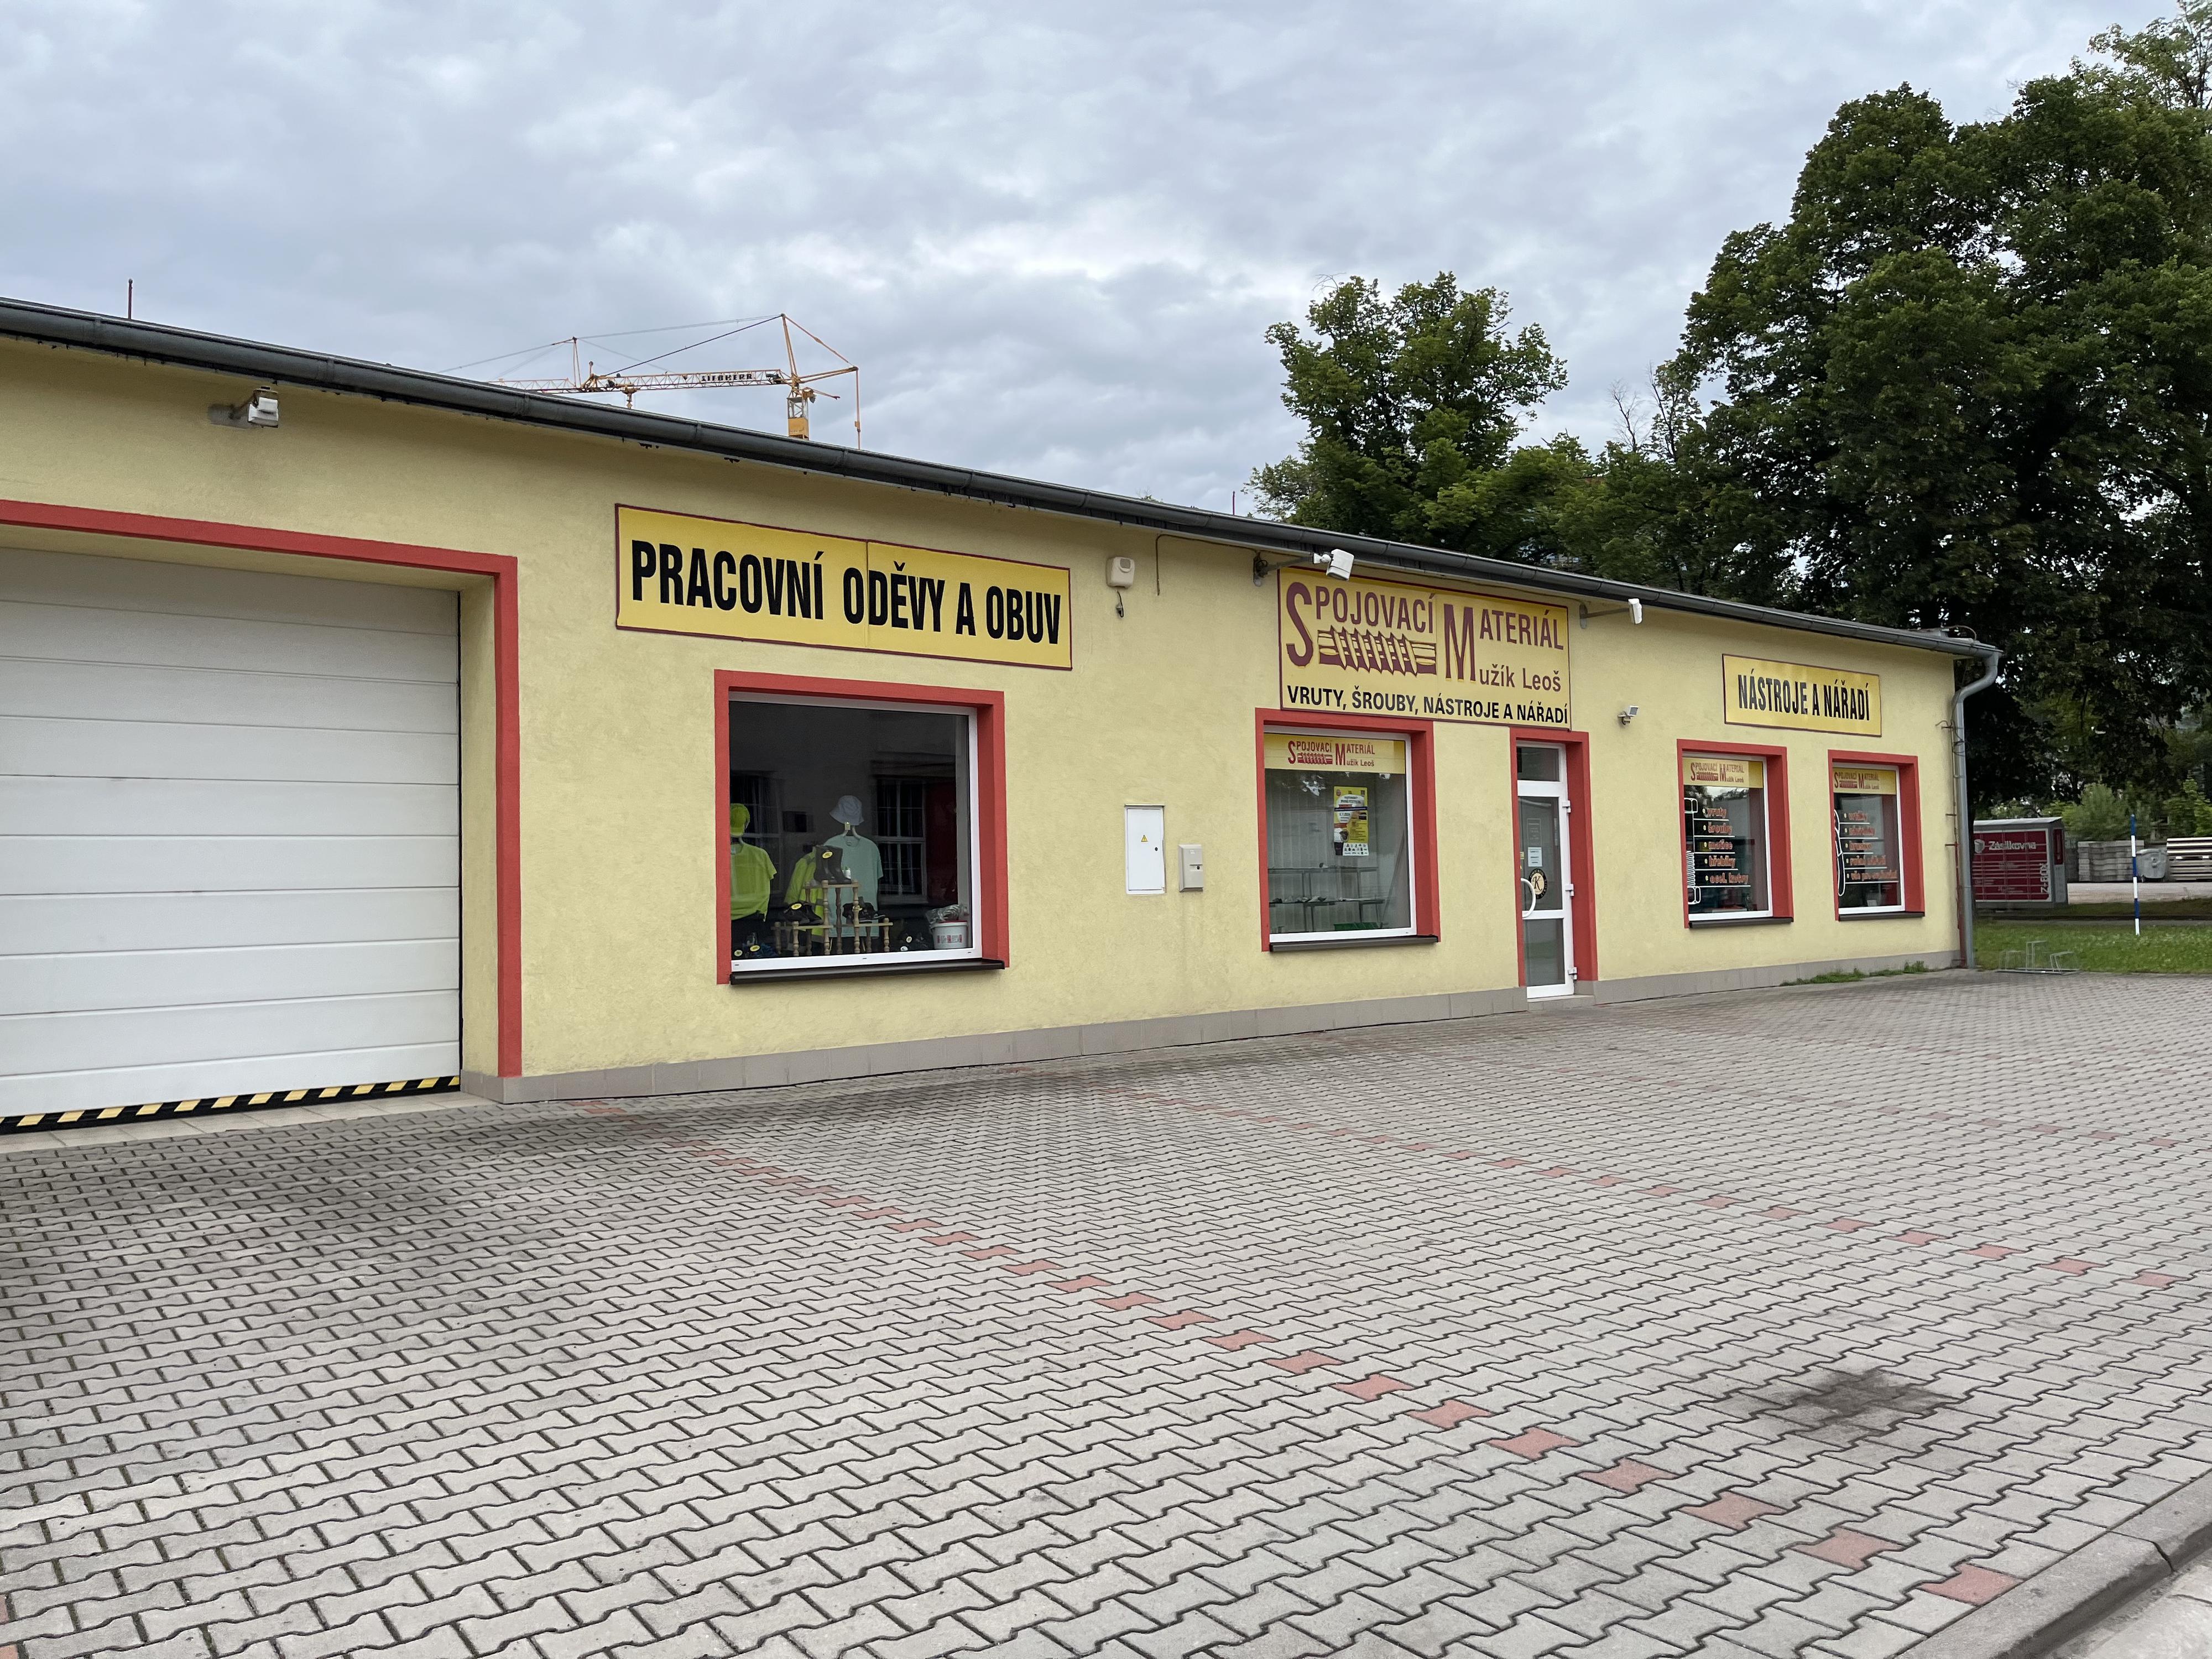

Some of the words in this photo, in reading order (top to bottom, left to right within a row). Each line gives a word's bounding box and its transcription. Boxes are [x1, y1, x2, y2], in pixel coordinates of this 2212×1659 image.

[632, 540, 823, 620] PRACOVNÍ
[843, 561, 945, 633] ODĚVY
[955, 582, 976, 636] A
[986, 585, 1061, 645] OBUV
[1286, 582, 1435, 667] SPOJOVACÍ
[1443, 603, 1564, 682] MATERIÁL
[1522, 668, 1561, 692] Leoš
[1738, 668, 1808, 714] NÁSTROJE
[1812, 684, 1820, 716] A
[1823, 679, 1870, 721] NÁŘADÍ
[1287, 685, 1347, 711] VRUTY,
[1352, 686, 1418, 715] ŠROUBY,
[1423, 692, 1499, 719] NÁSTROJE
[1504, 703, 1513, 720] A
[1517, 700, 1568, 724] NÁŘADÍ
[1287, 740, 1332, 764] SPOJOVACÍ
[1335, 742, 1375, 766] MATERIÁL
